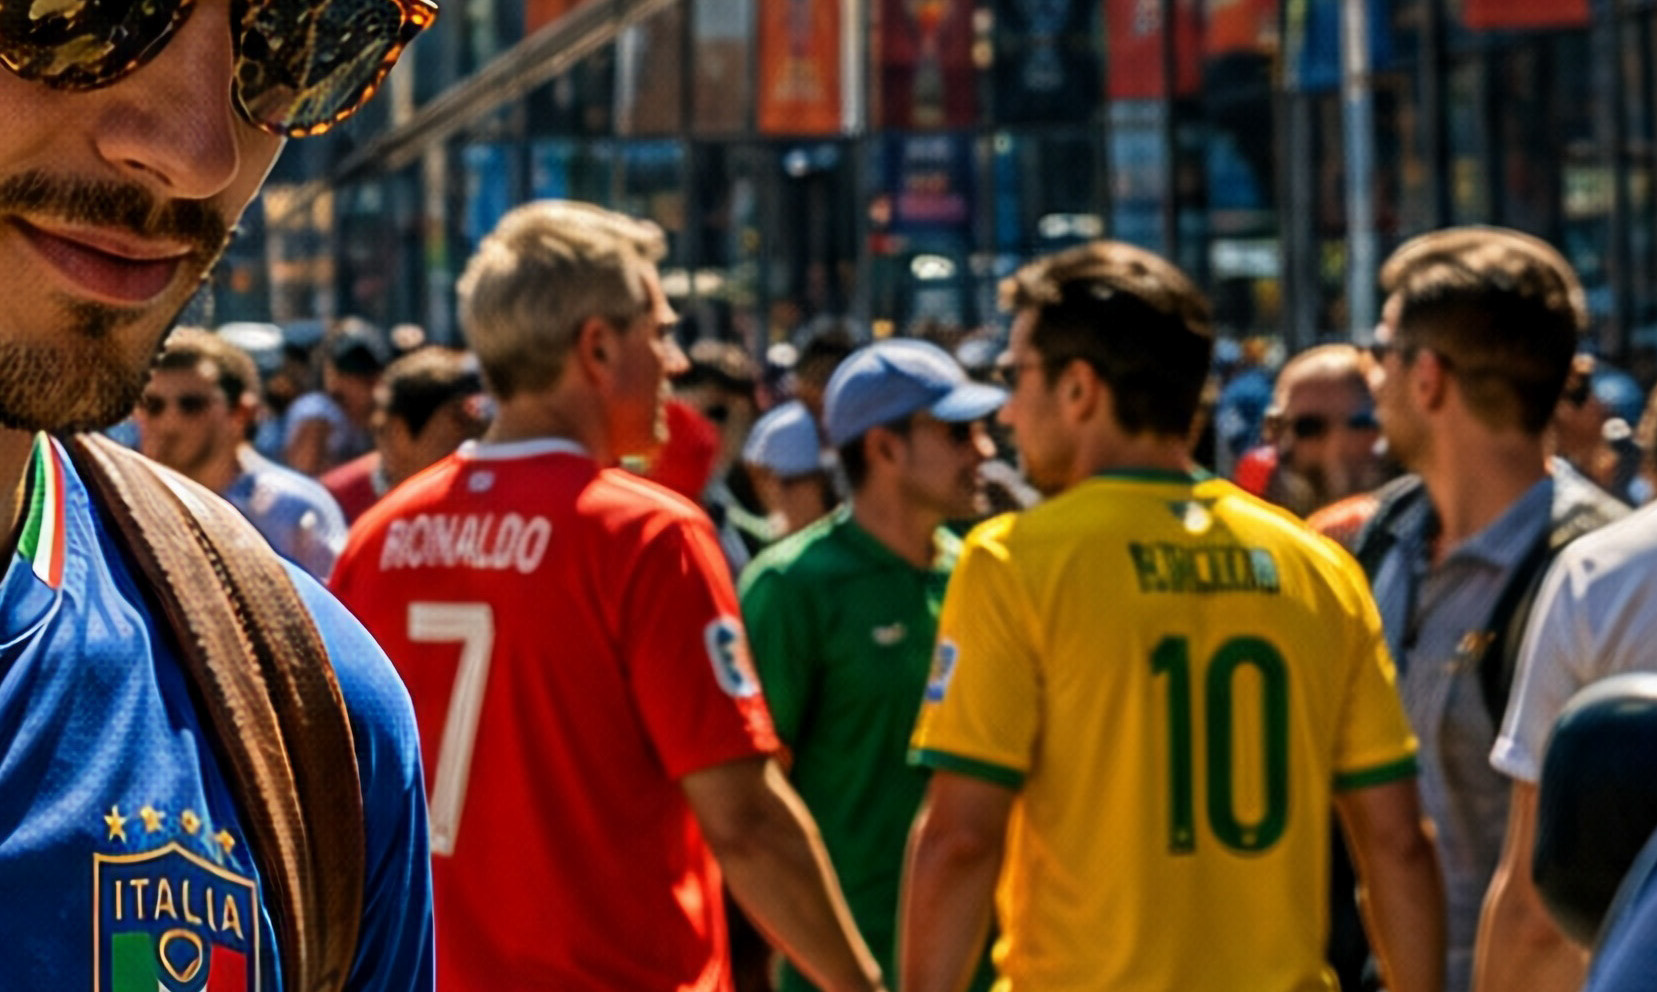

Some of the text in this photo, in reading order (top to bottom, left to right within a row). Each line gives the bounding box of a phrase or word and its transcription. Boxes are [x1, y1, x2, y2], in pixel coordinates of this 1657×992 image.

[379, 511, 552, 574] RONALDO
[407, 601, 494, 857] 7
[1148, 633, 1291, 859] 10
[115, 877, 244, 940] ITALIA
